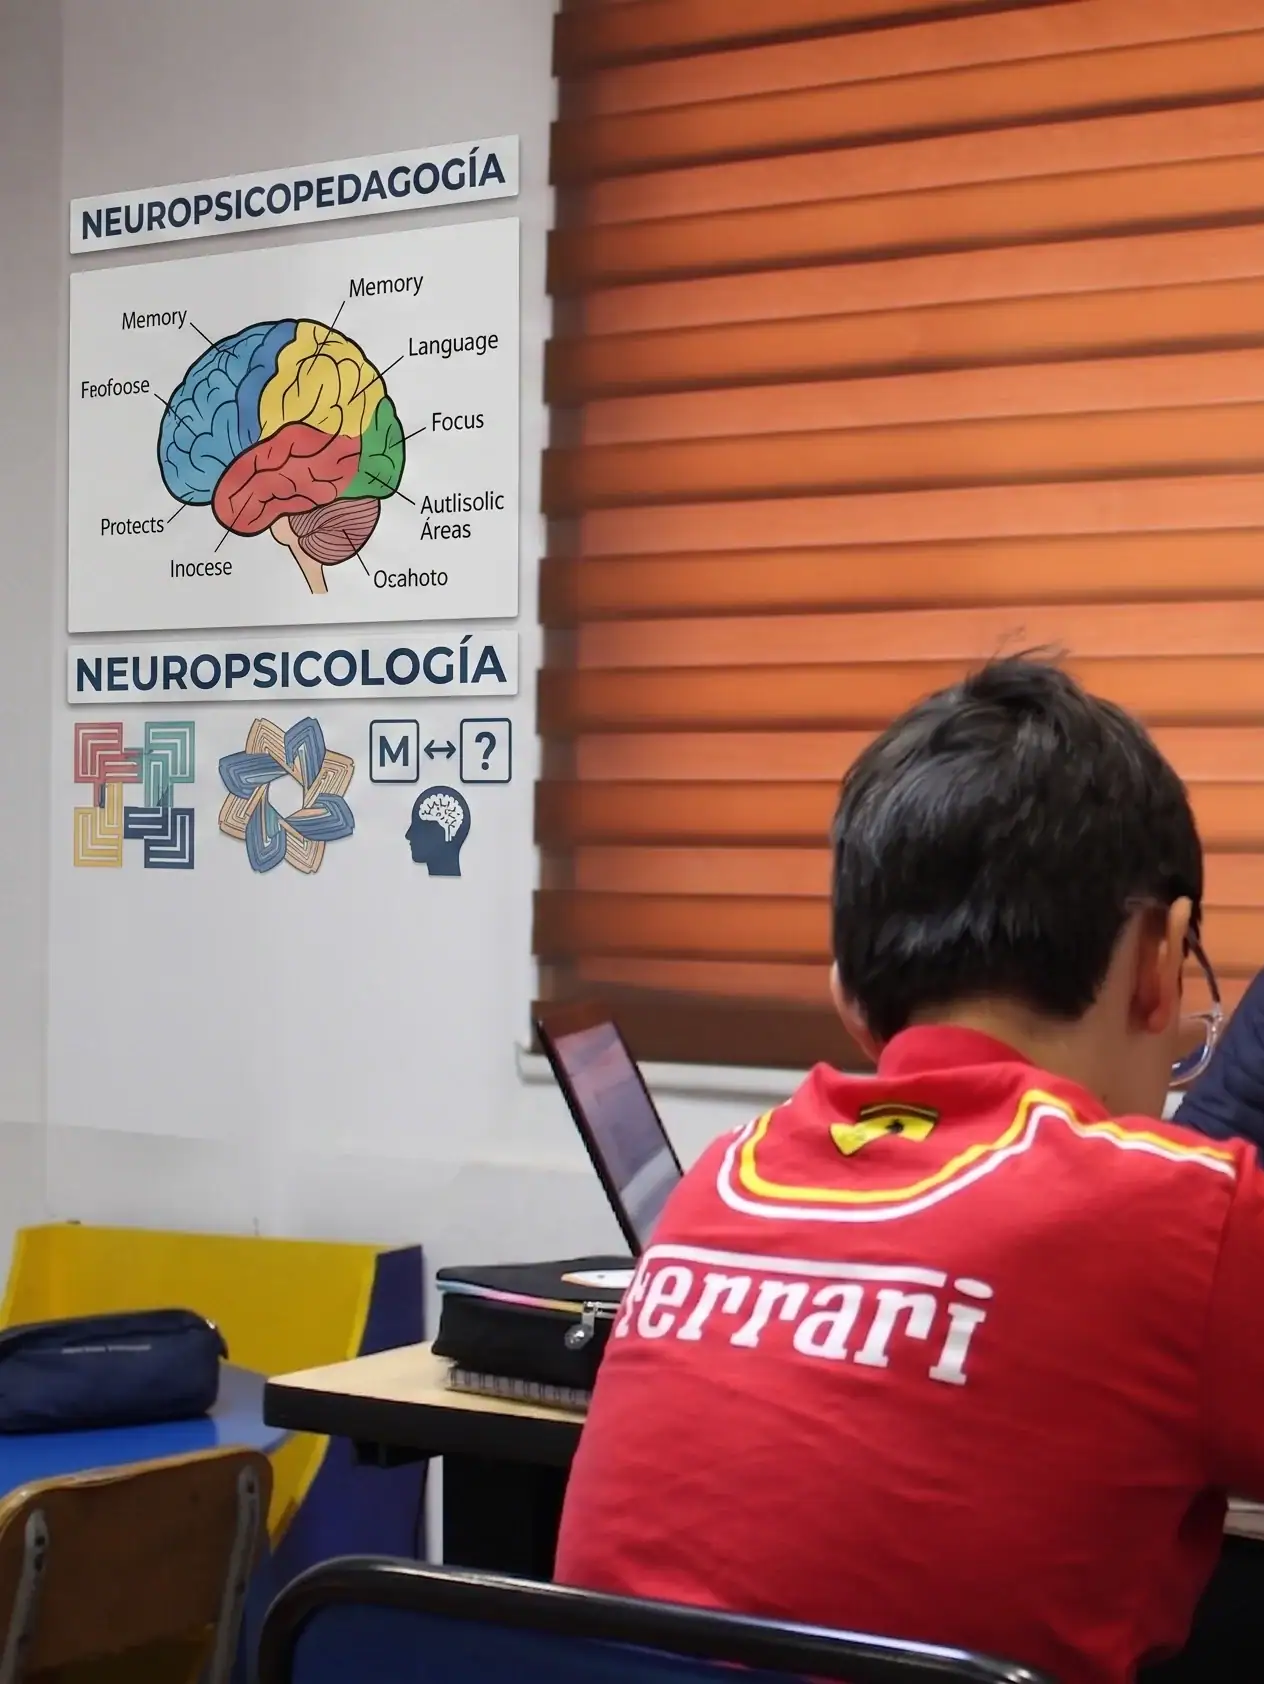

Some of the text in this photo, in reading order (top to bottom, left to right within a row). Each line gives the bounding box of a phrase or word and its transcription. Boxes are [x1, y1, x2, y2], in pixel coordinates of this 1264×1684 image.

[82, 146, 505, 241] NEUROPSICOPEDAGOGÍA
[348, 275, 424, 300] Memory
[121, 308, 187, 332] Memory
[408, 331, 499, 359] Language
[431, 411, 484, 433] Focus
[420, 490, 505, 515] Autlisolic
[100, 516, 165, 536] Protects
[419, 517, 471, 541] Áreas
[170, 559, 233, 578] Inocese
[76, 634, 507, 692] NEUROPSICOLOGÍA
[379, 731, 497, 770] M ?
